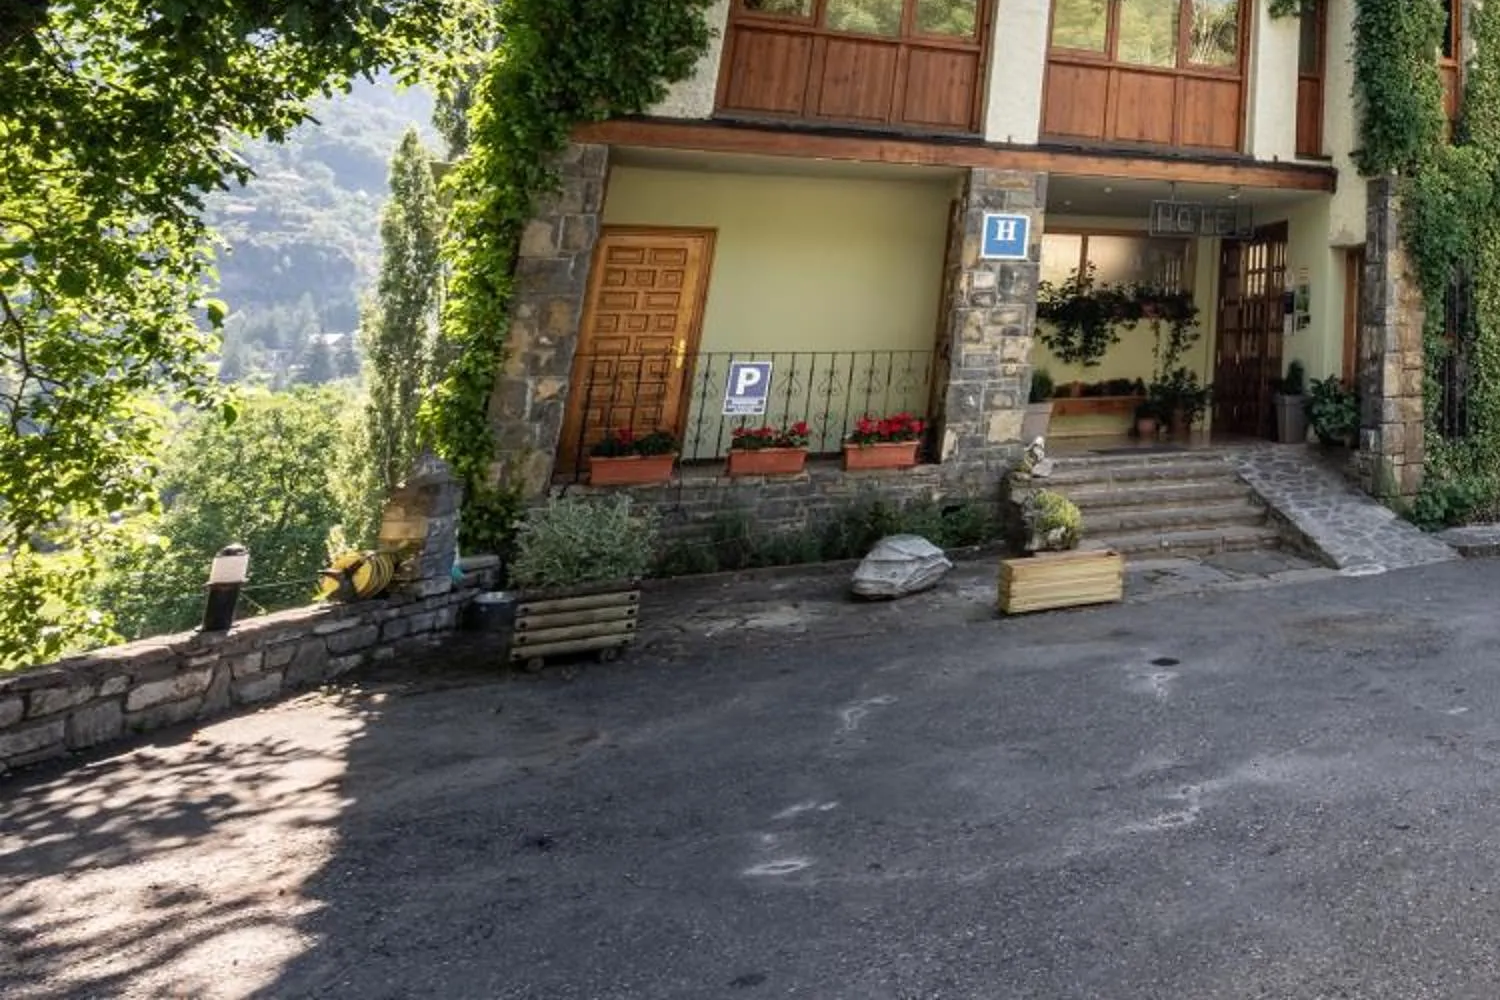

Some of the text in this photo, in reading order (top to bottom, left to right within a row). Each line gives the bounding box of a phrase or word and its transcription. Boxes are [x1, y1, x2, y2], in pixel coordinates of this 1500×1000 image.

[994, 219, 1017, 241] H
[1156, 203, 1253, 236] HOTEL
[735, 367, 761, 395] P
